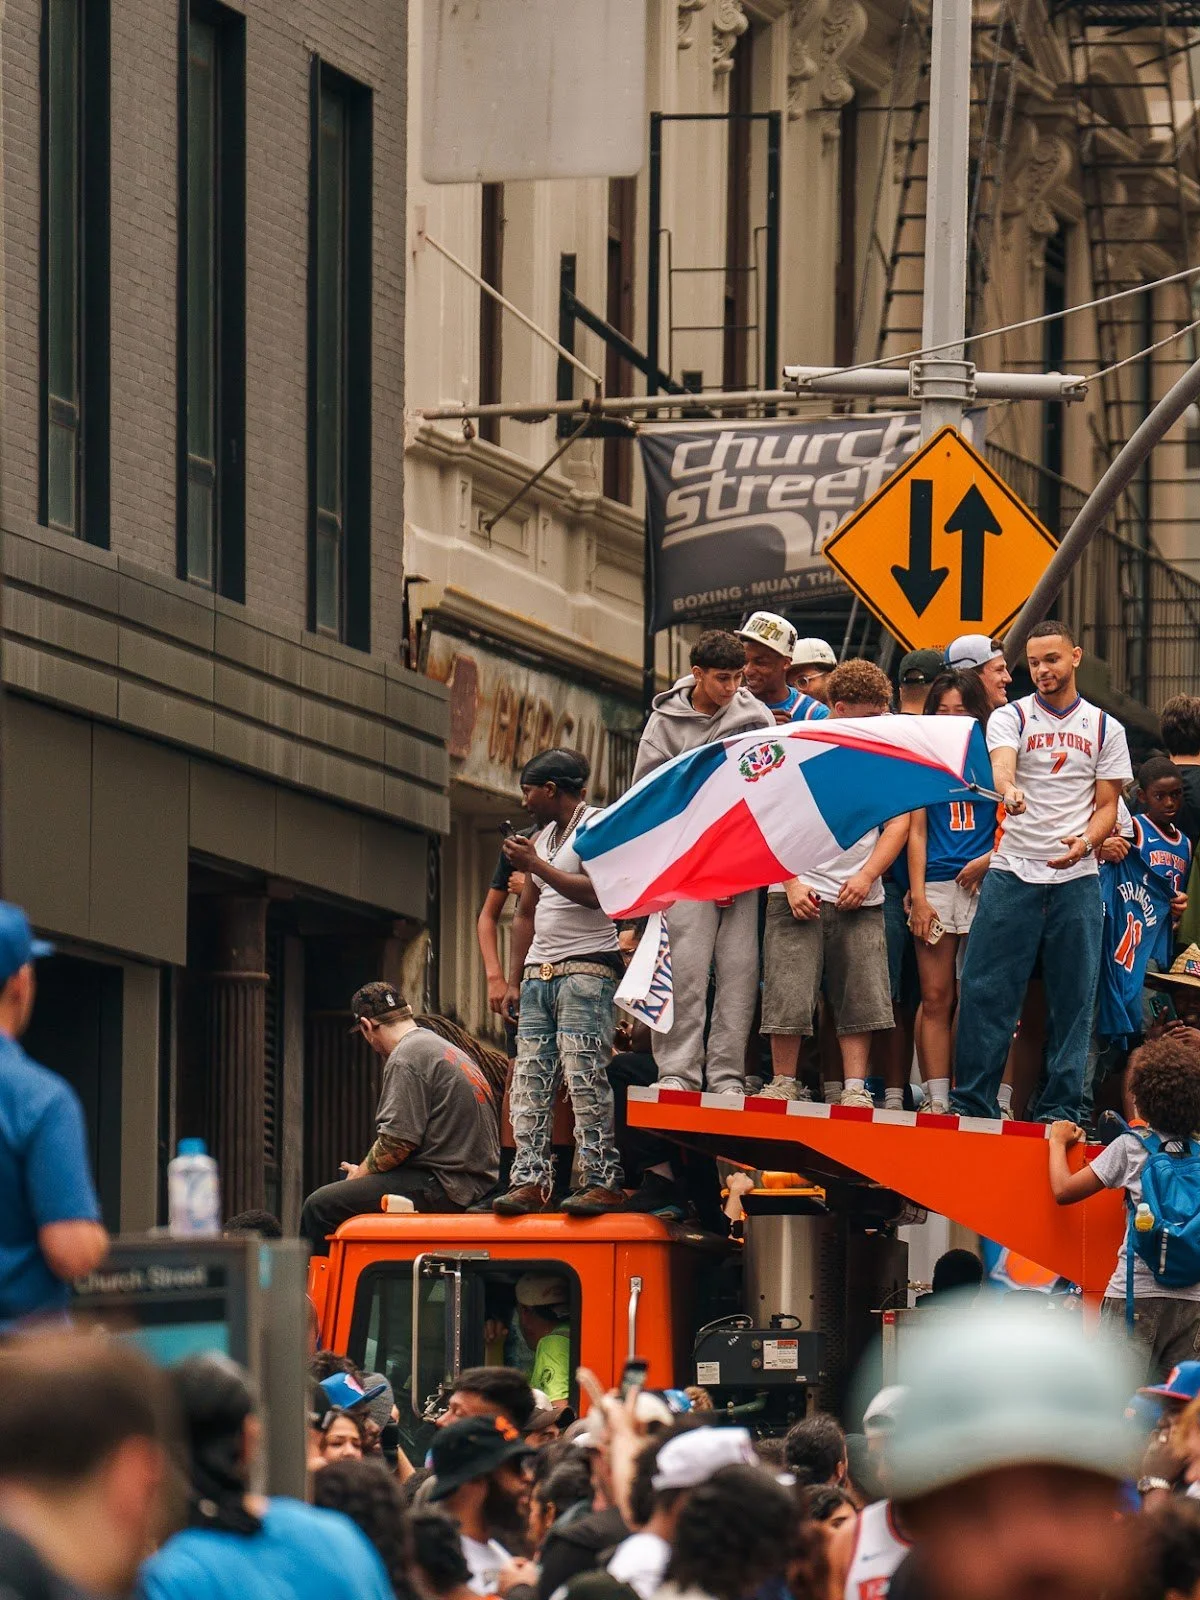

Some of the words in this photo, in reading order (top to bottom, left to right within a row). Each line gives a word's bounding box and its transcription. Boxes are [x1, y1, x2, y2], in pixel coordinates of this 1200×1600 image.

[664, 455, 898, 533] street
[672, 585, 743, 613] BOXING
[751, 574, 801, 597] MUAY
[1026, 732, 1056, 753] NEW
[1057, 731, 1093, 760] YORK
[1050, 751, 1068, 775] 7
[949, 801, 976, 831] 11
[1149, 850, 1173, 868] NEW
[1117, 881, 1157, 928] BRUNSON
